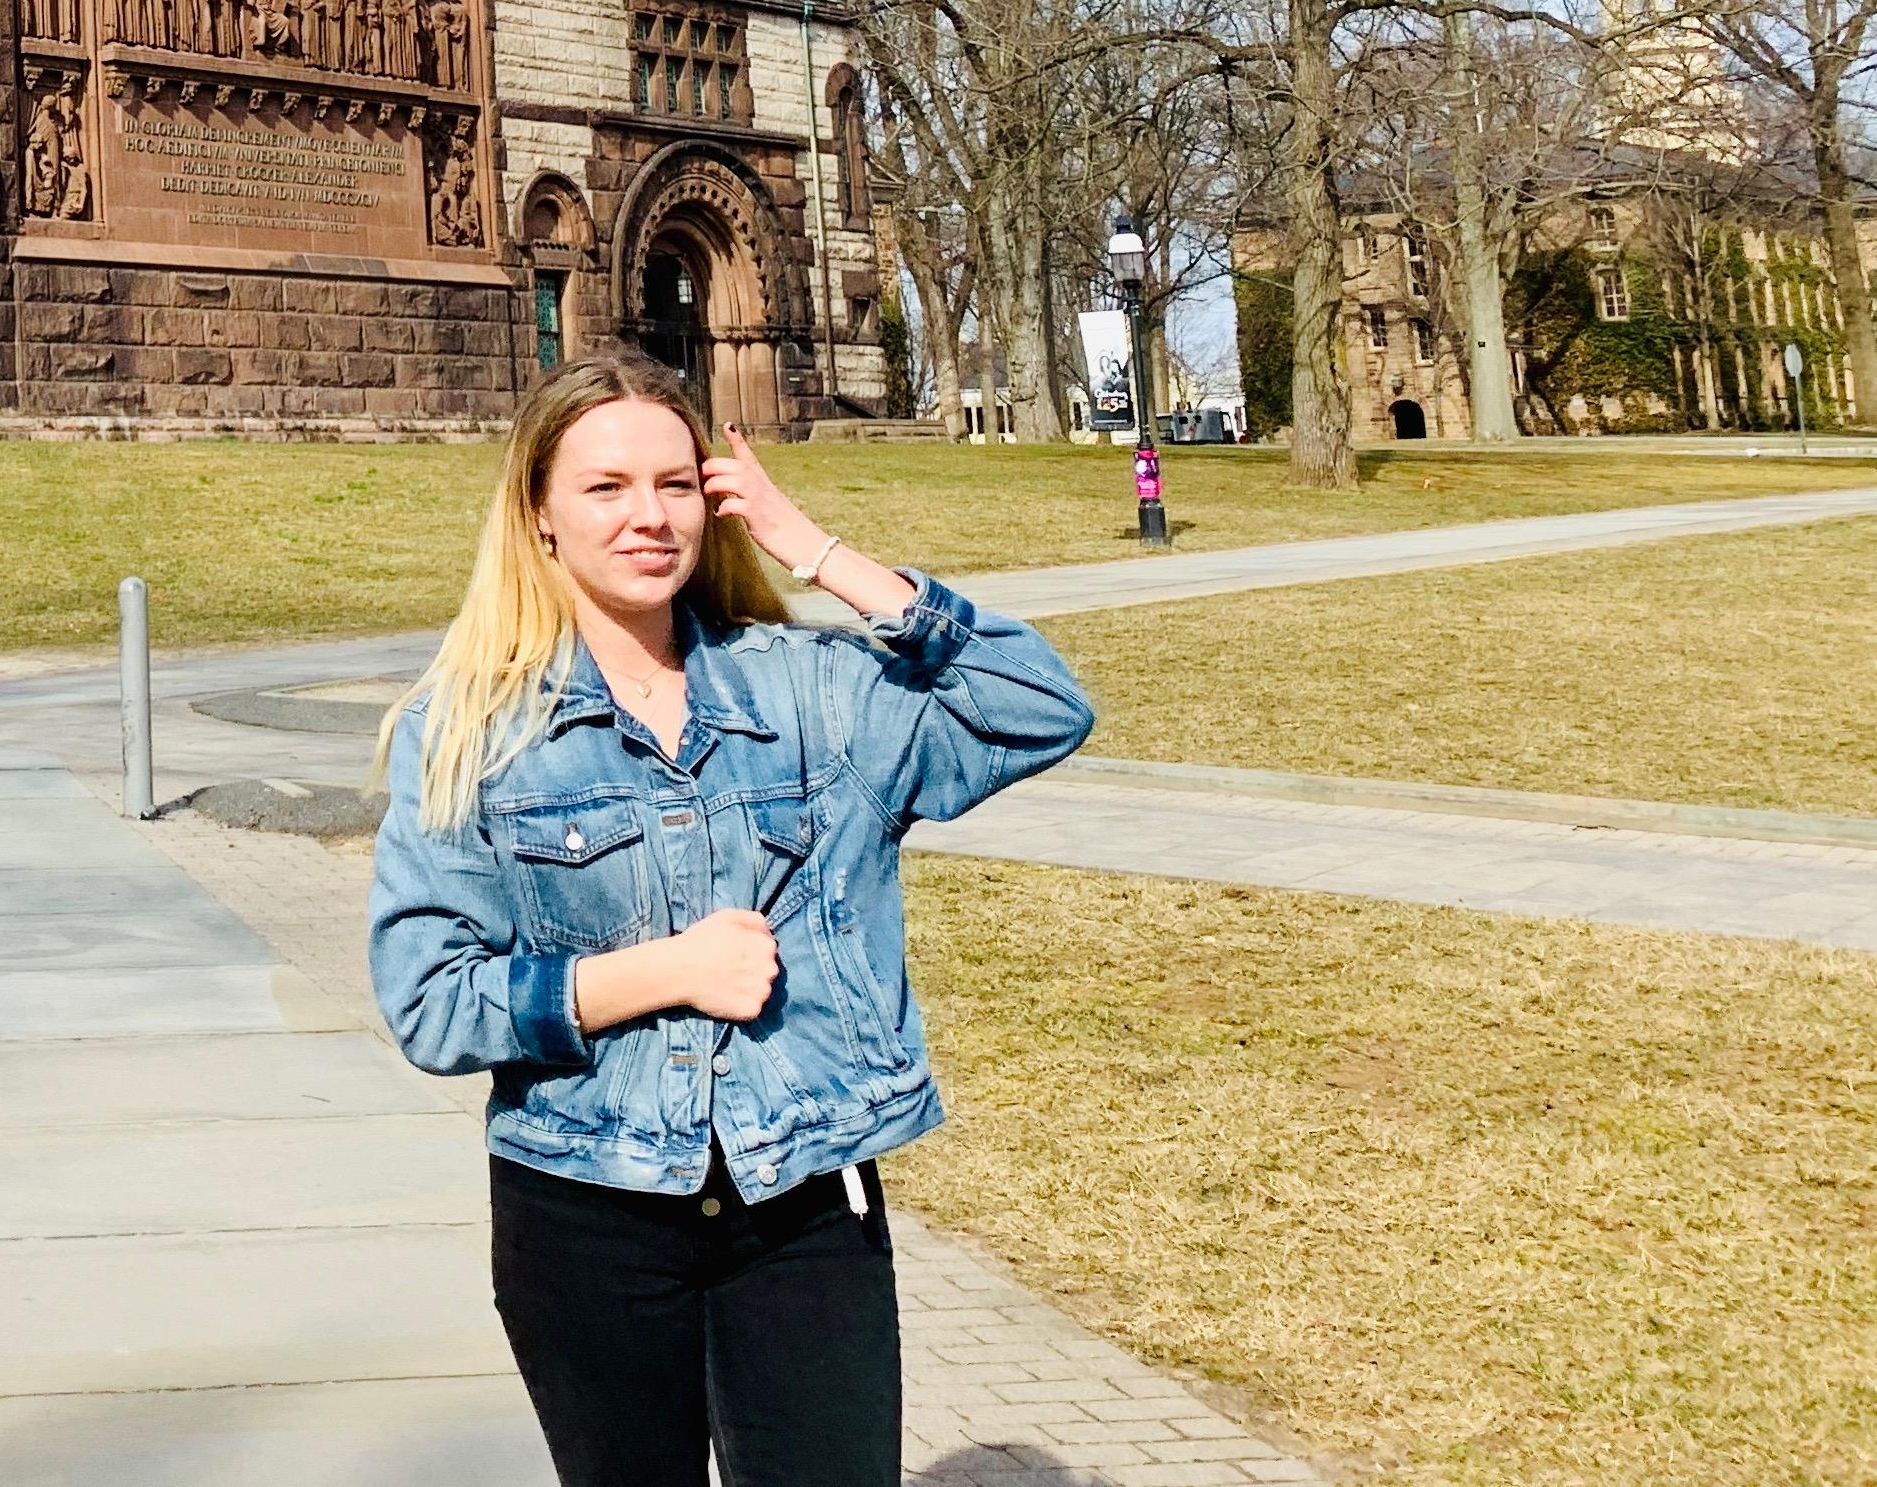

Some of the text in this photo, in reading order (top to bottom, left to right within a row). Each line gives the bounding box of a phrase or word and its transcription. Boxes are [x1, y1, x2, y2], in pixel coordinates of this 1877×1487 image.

[142, 120, 199, 139] GLORIAM
[125, 136, 154, 153] HOC
[182, 159, 359, 189] HARRIET CROCKER ALEXANDER
[161, 175, 197, 192] DEDIT
